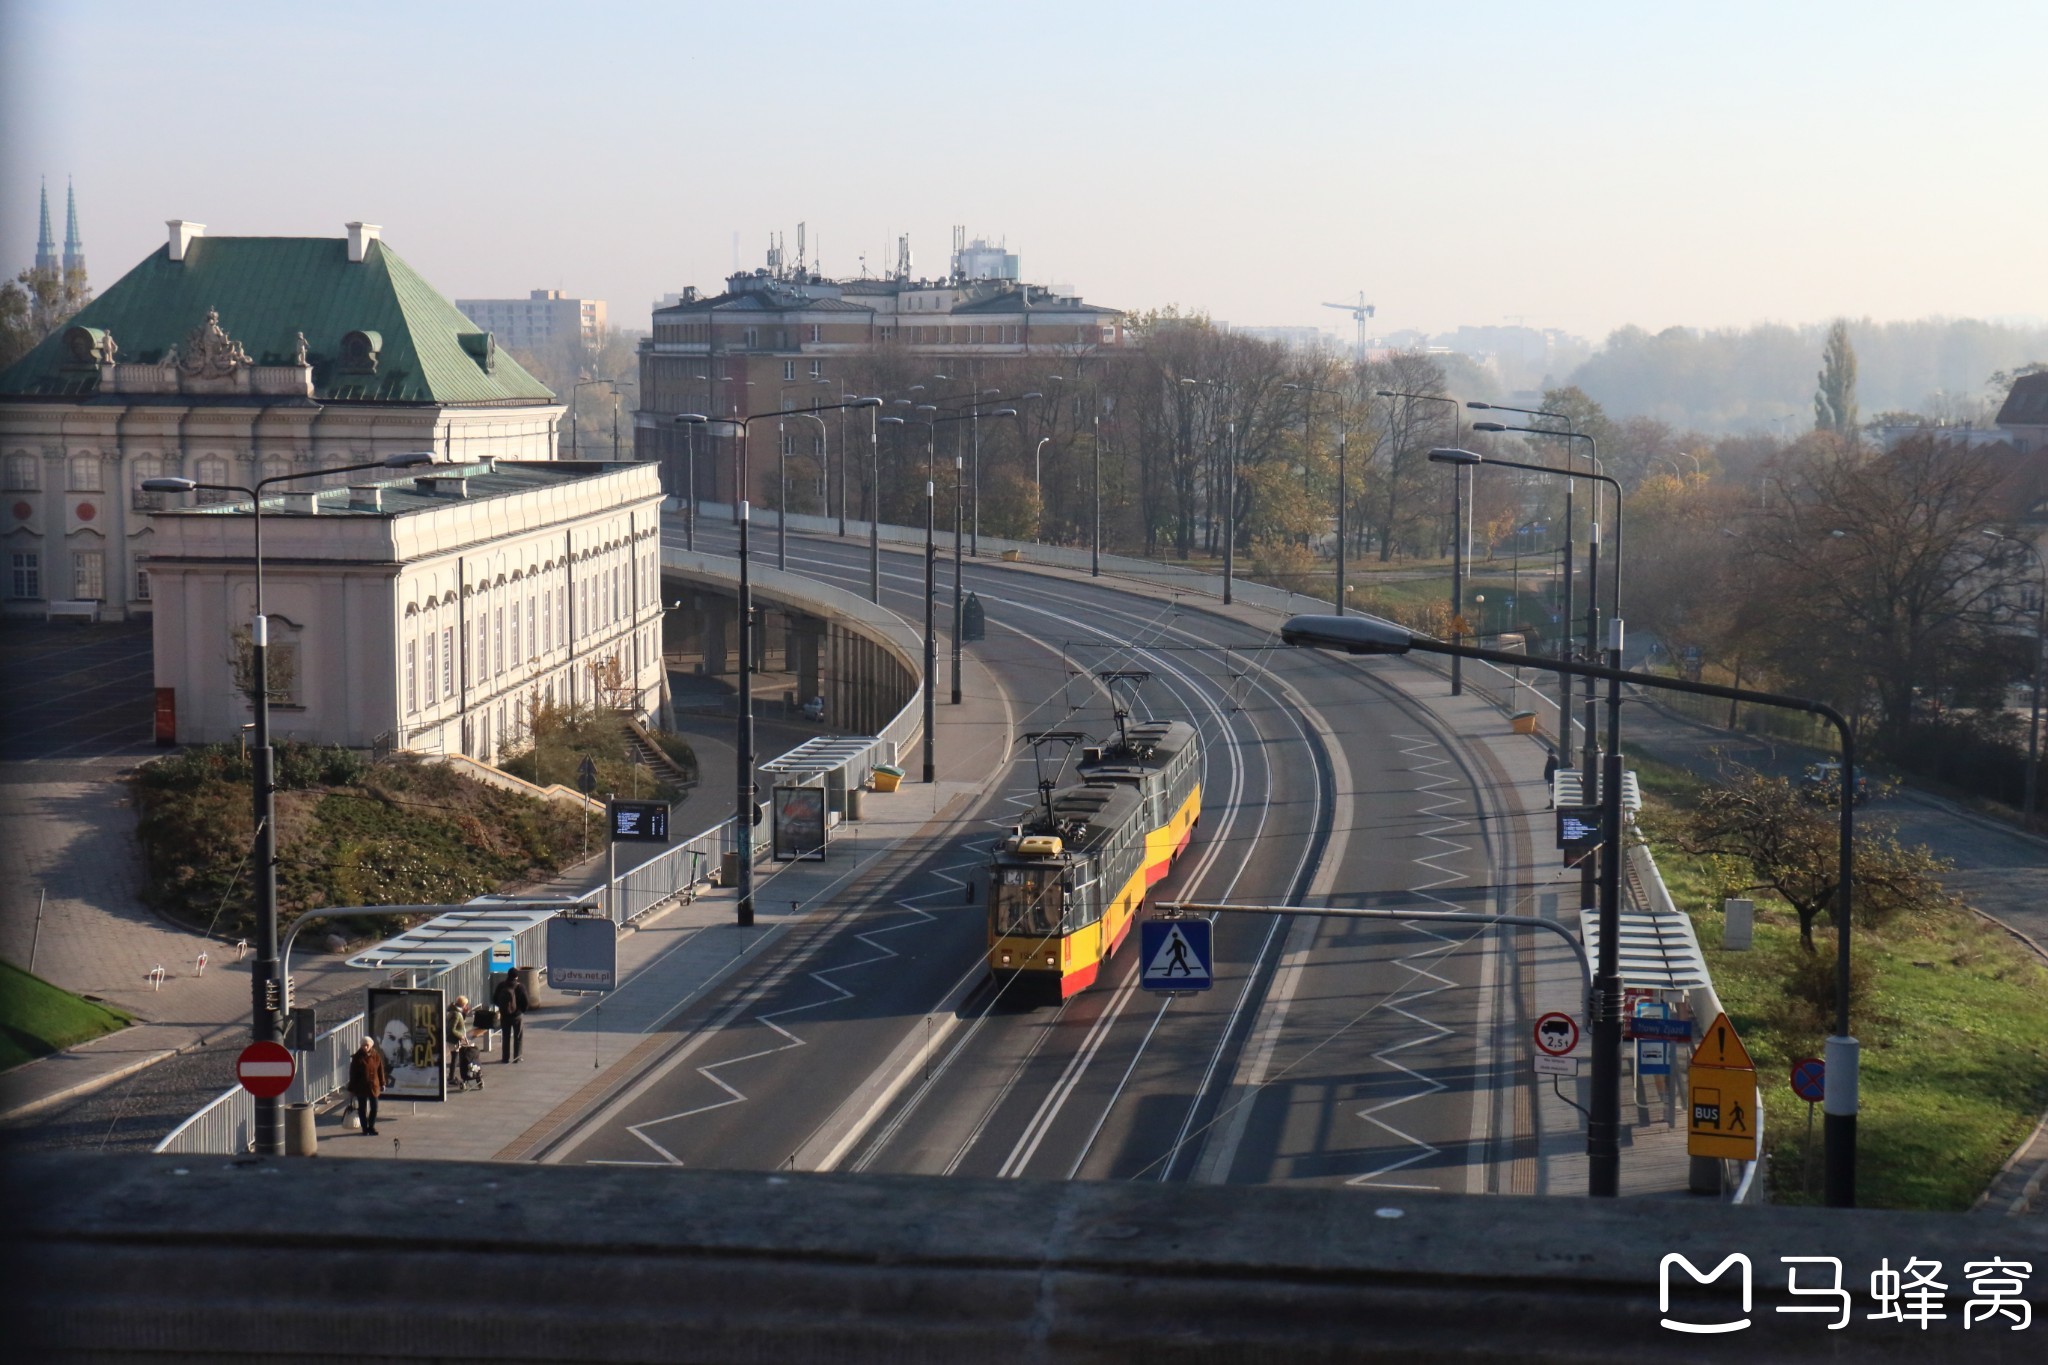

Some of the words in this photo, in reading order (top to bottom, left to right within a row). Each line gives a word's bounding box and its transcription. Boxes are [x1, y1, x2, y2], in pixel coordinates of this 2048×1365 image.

[566, 970, 609, 983] dvs.net.pl
[1663, 1024, 1684, 1036] Zjazd
[1547, 1036, 1563, 1048] 2,5
[1695, 1107, 1718, 1120] BUS
